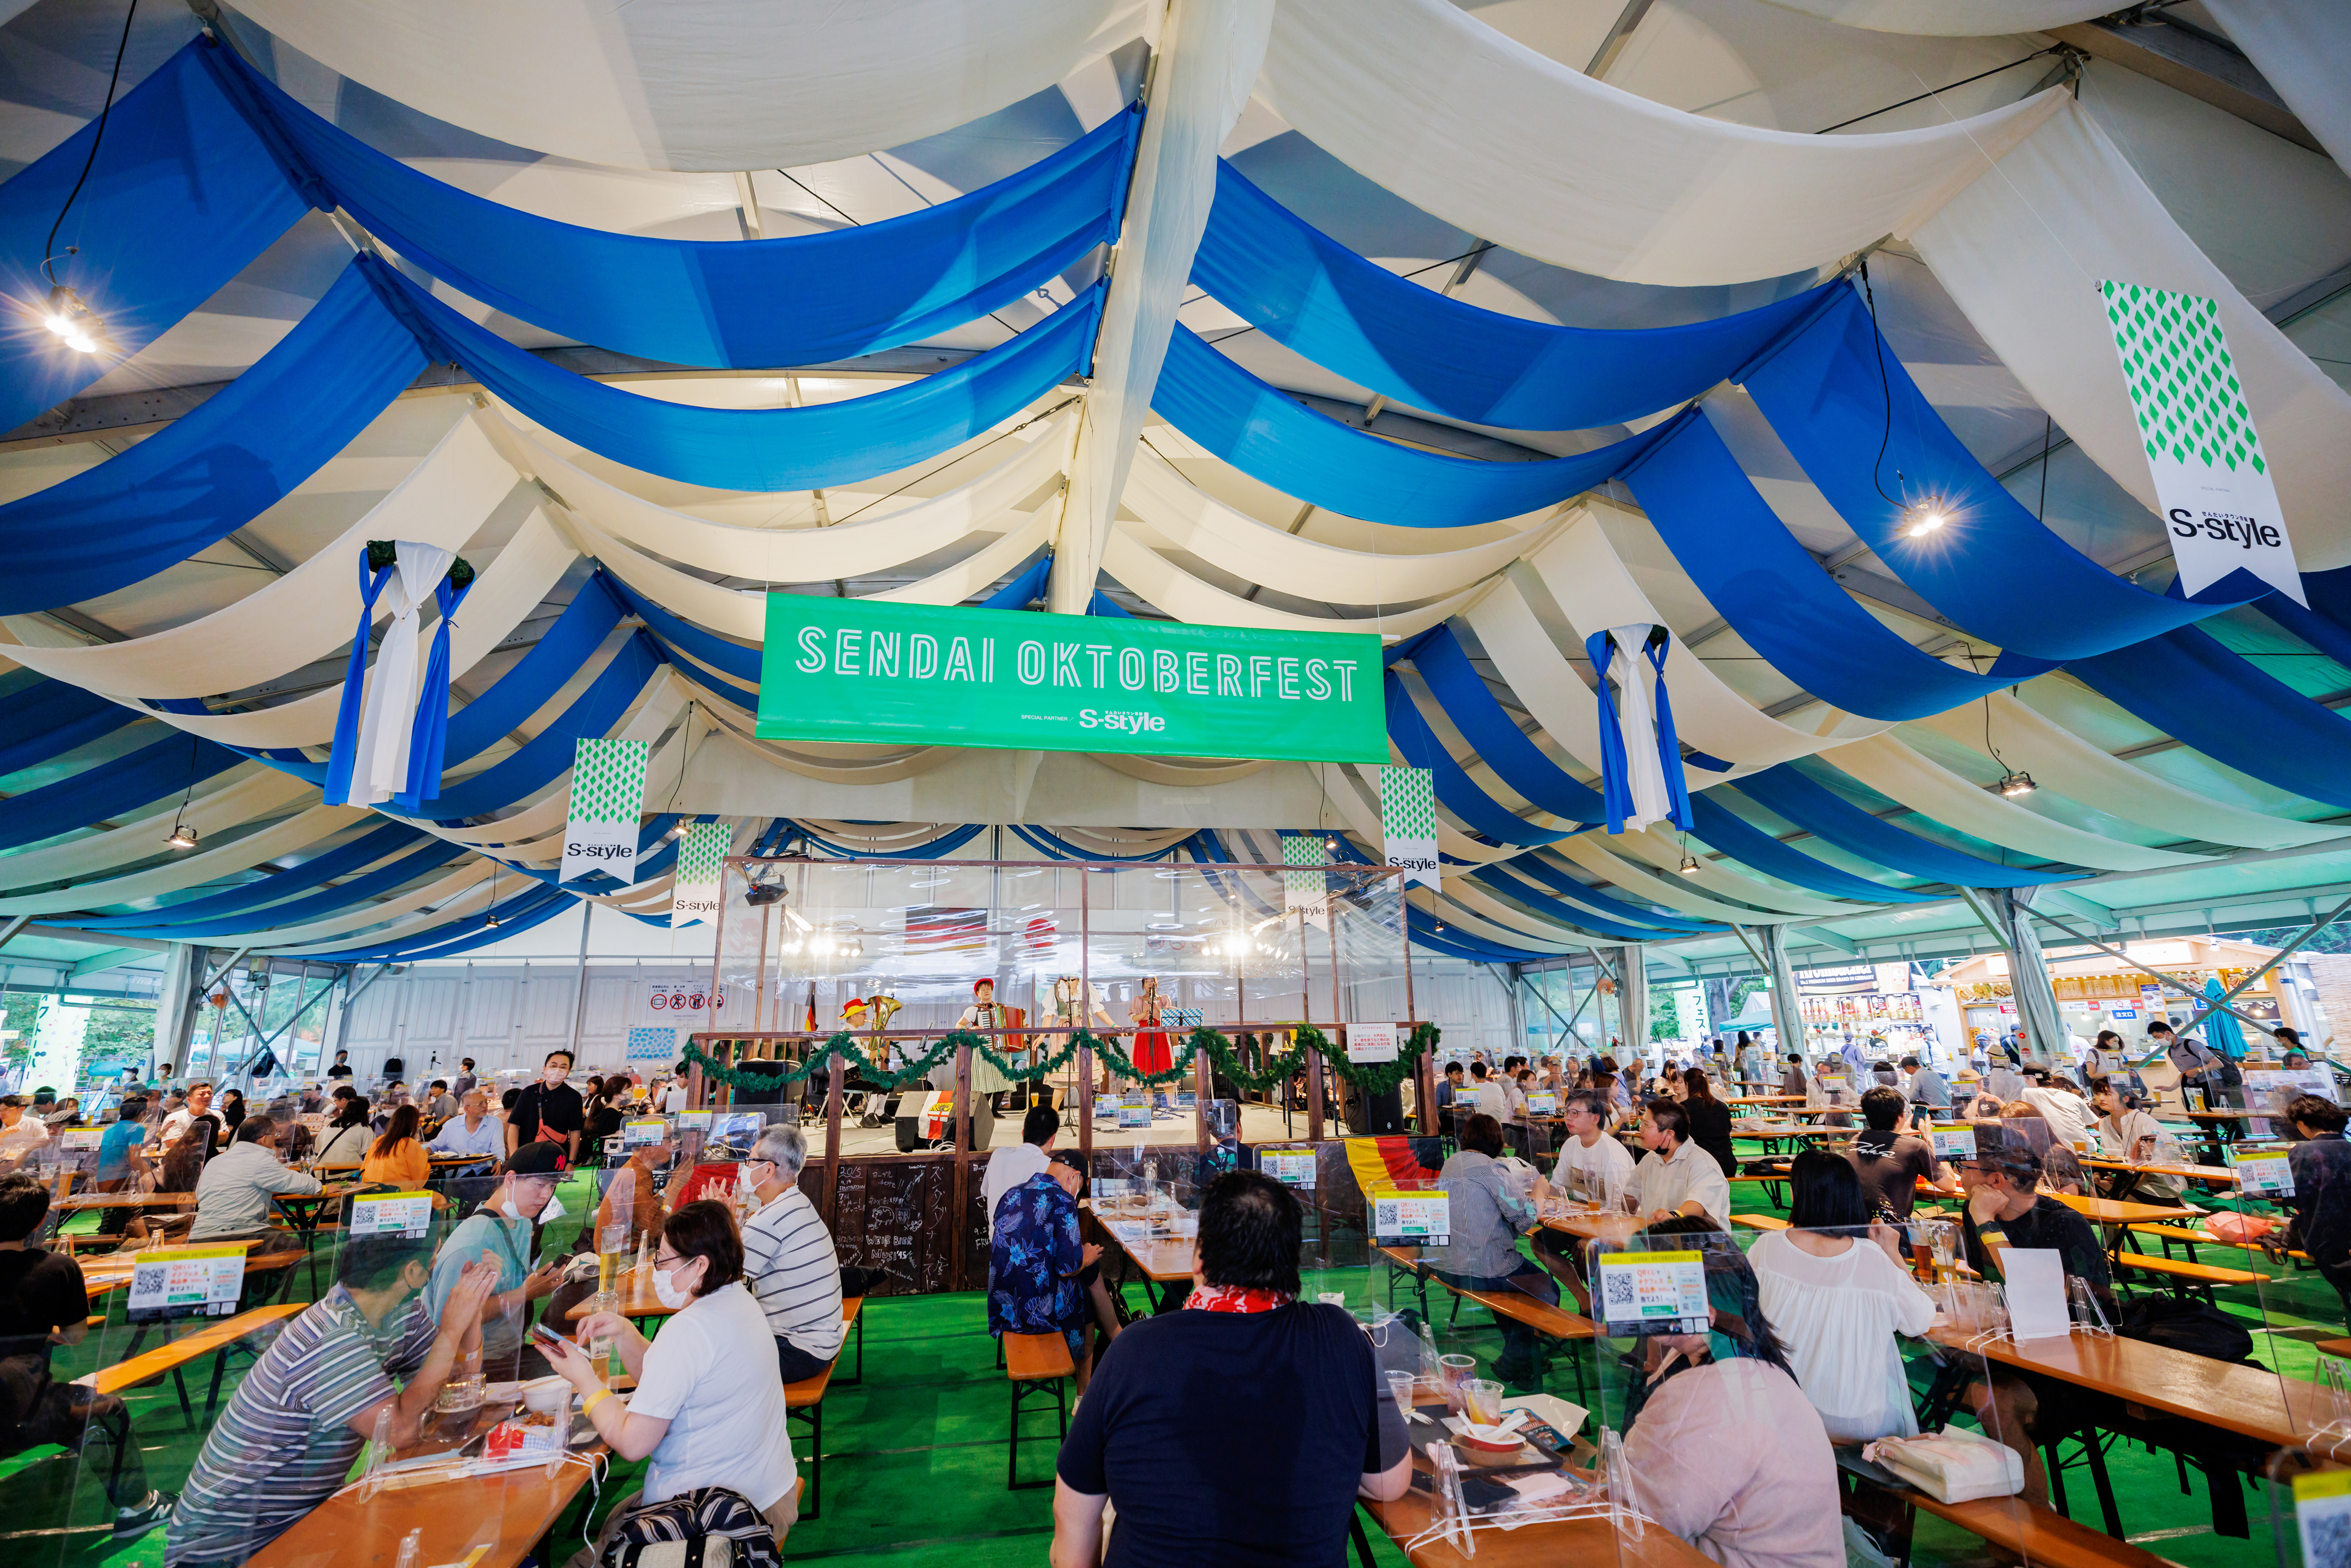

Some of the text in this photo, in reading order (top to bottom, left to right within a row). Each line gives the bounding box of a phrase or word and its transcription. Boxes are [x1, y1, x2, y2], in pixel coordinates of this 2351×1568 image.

[2169, 509, 2281, 549] S-style
[795, 626, 1357, 702] SENDAI OKTOBERFEST
[1079, 709, 1165, 734] S-style
[567, 843, 632, 859] S-style
[1389, 857, 1436, 871] S-style
[676, 900, 720, 912] S-style
[555, 1155, 566, 1171] NY
[841, 1166, 861, 1177] 2015
[893, 1236, 913, 1246] BIER
